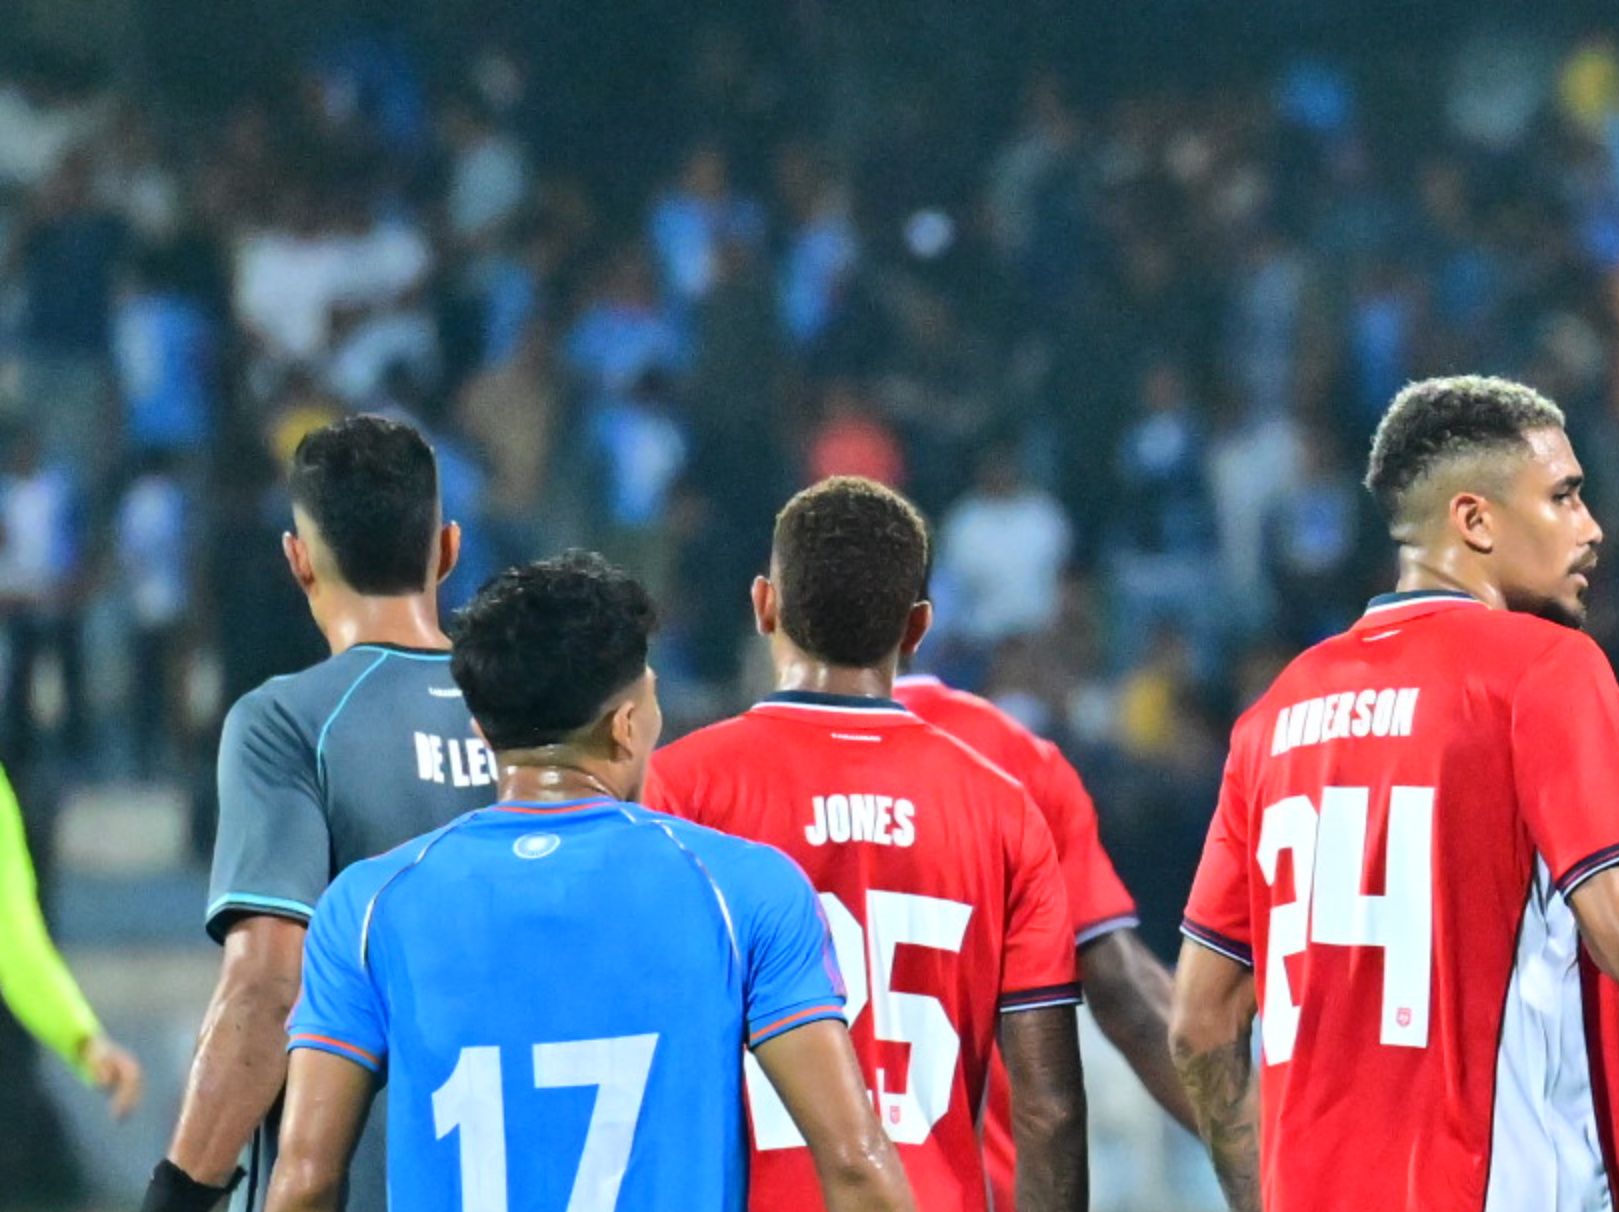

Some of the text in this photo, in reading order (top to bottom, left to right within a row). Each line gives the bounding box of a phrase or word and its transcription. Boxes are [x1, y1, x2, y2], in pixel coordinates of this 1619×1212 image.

[1271, 688, 1420, 757] ANDERSON
[414, 731, 445, 784] DE
[804, 793, 916, 847] JONES
[1257, 786, 1435, 1066] 24
